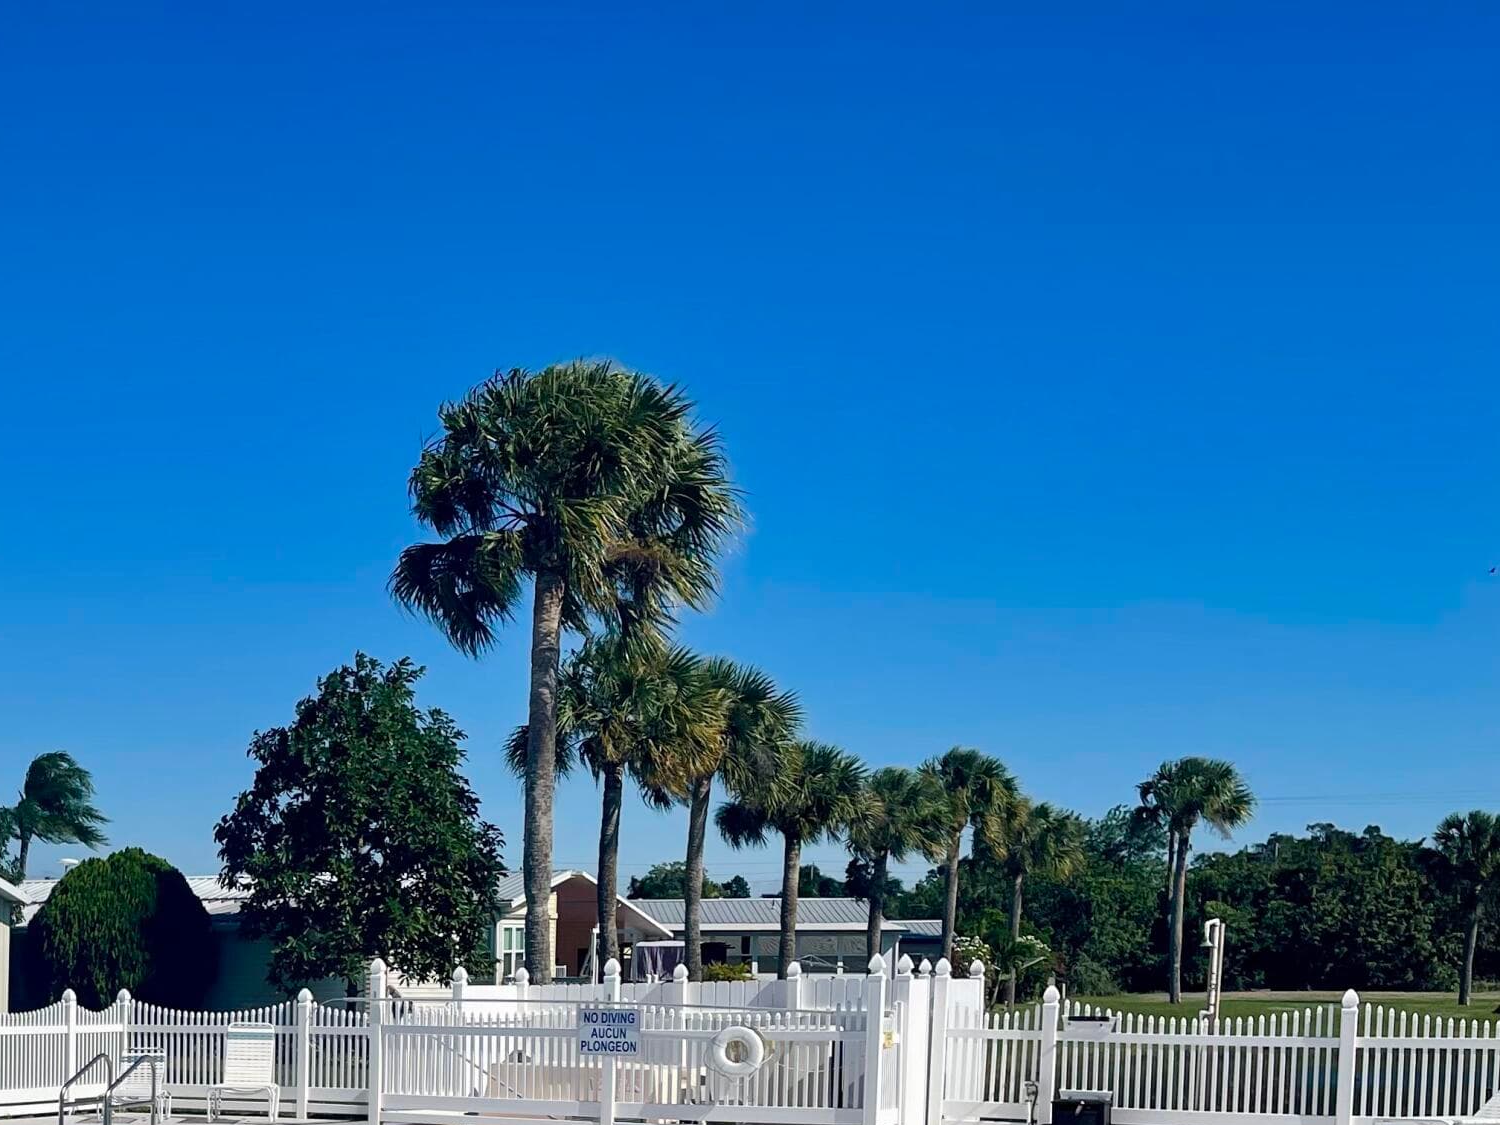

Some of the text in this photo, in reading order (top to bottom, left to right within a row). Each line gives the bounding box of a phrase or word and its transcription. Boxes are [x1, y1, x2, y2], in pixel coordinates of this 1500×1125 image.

[584, 1012, 635, 1024] NO DIVING
[591, 1028, 626, 1039] AUCUN
[581, 1040, 636, 1052] PLONGEON
